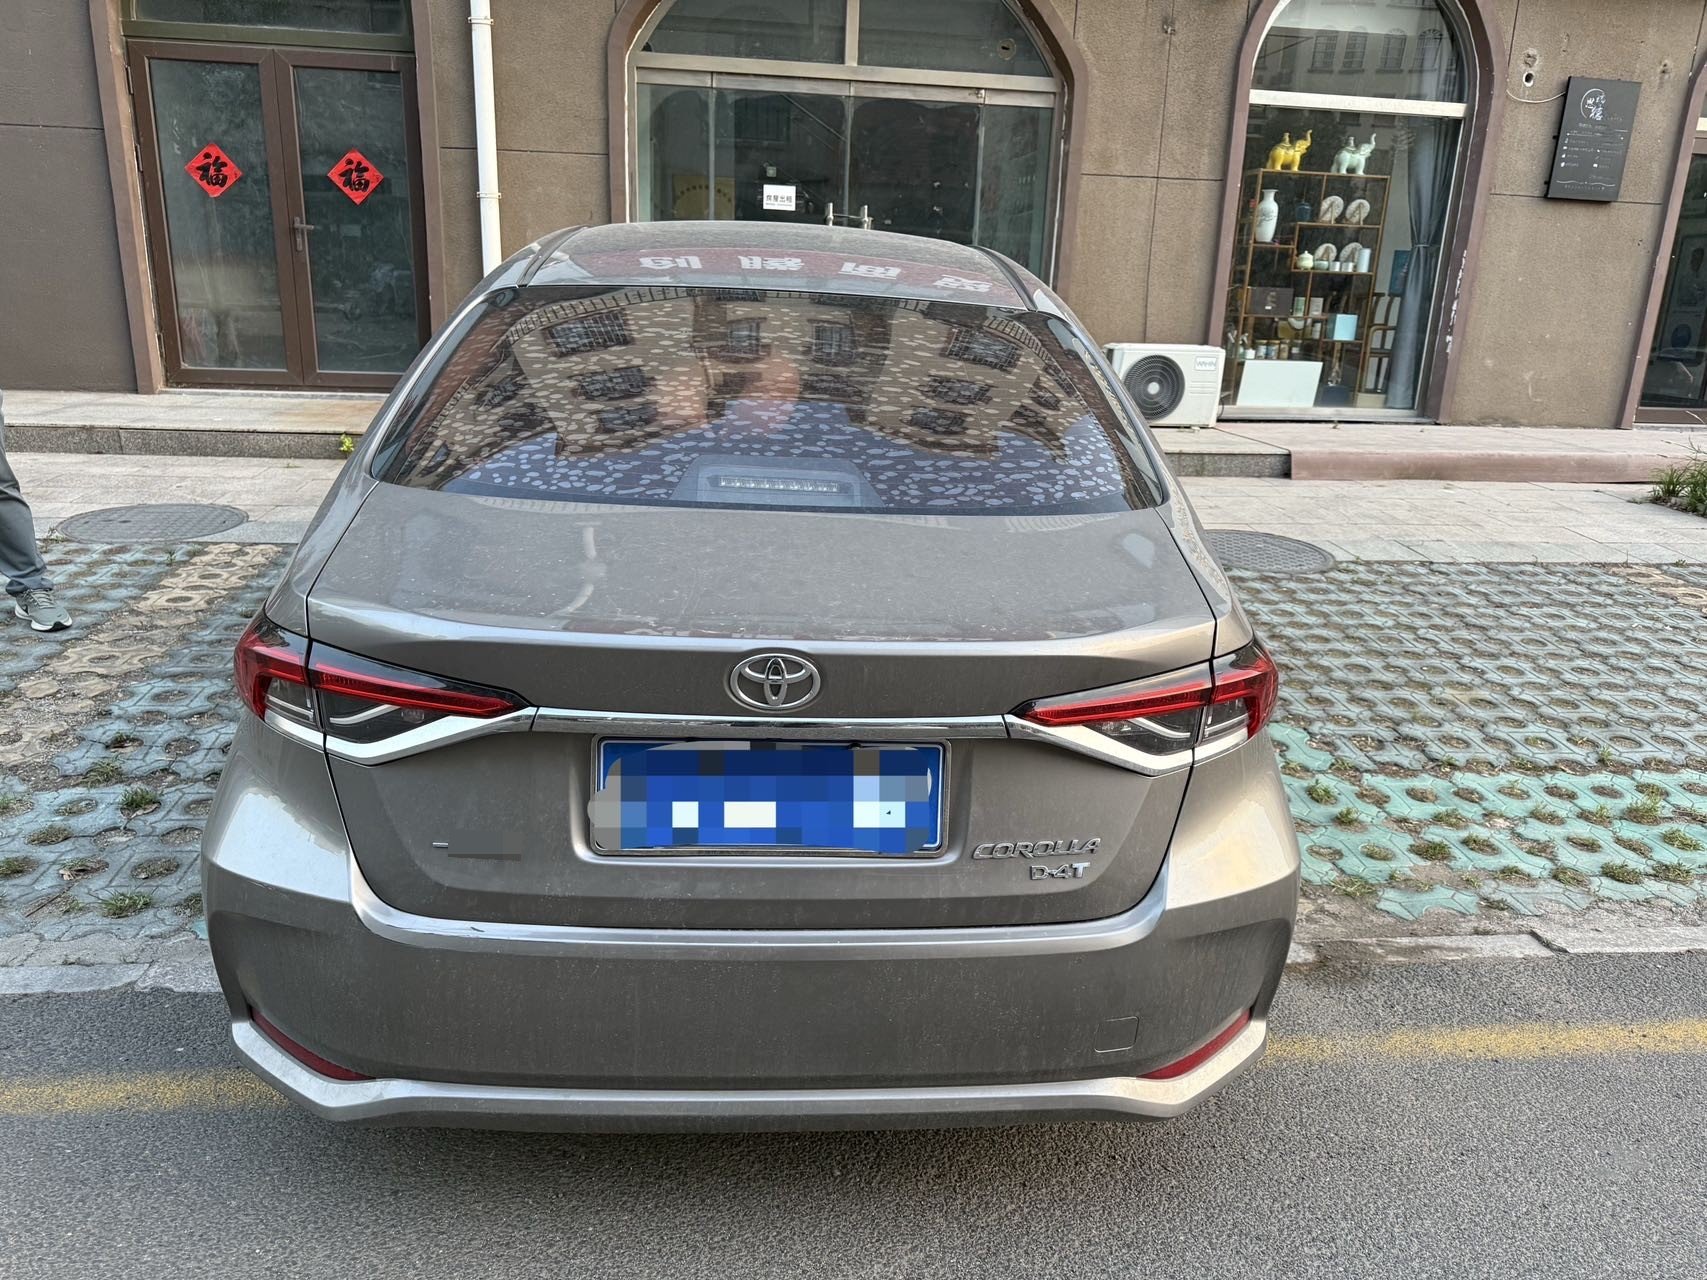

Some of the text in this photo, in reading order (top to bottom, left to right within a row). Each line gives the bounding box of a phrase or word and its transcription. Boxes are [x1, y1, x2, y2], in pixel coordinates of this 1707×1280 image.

[196, 152, 228, 188] 福
[338, 158, 370, 192] 福
[973, 837, 1101, 860] COROLLA
[1031, 861, 1091, 881] D-4T
